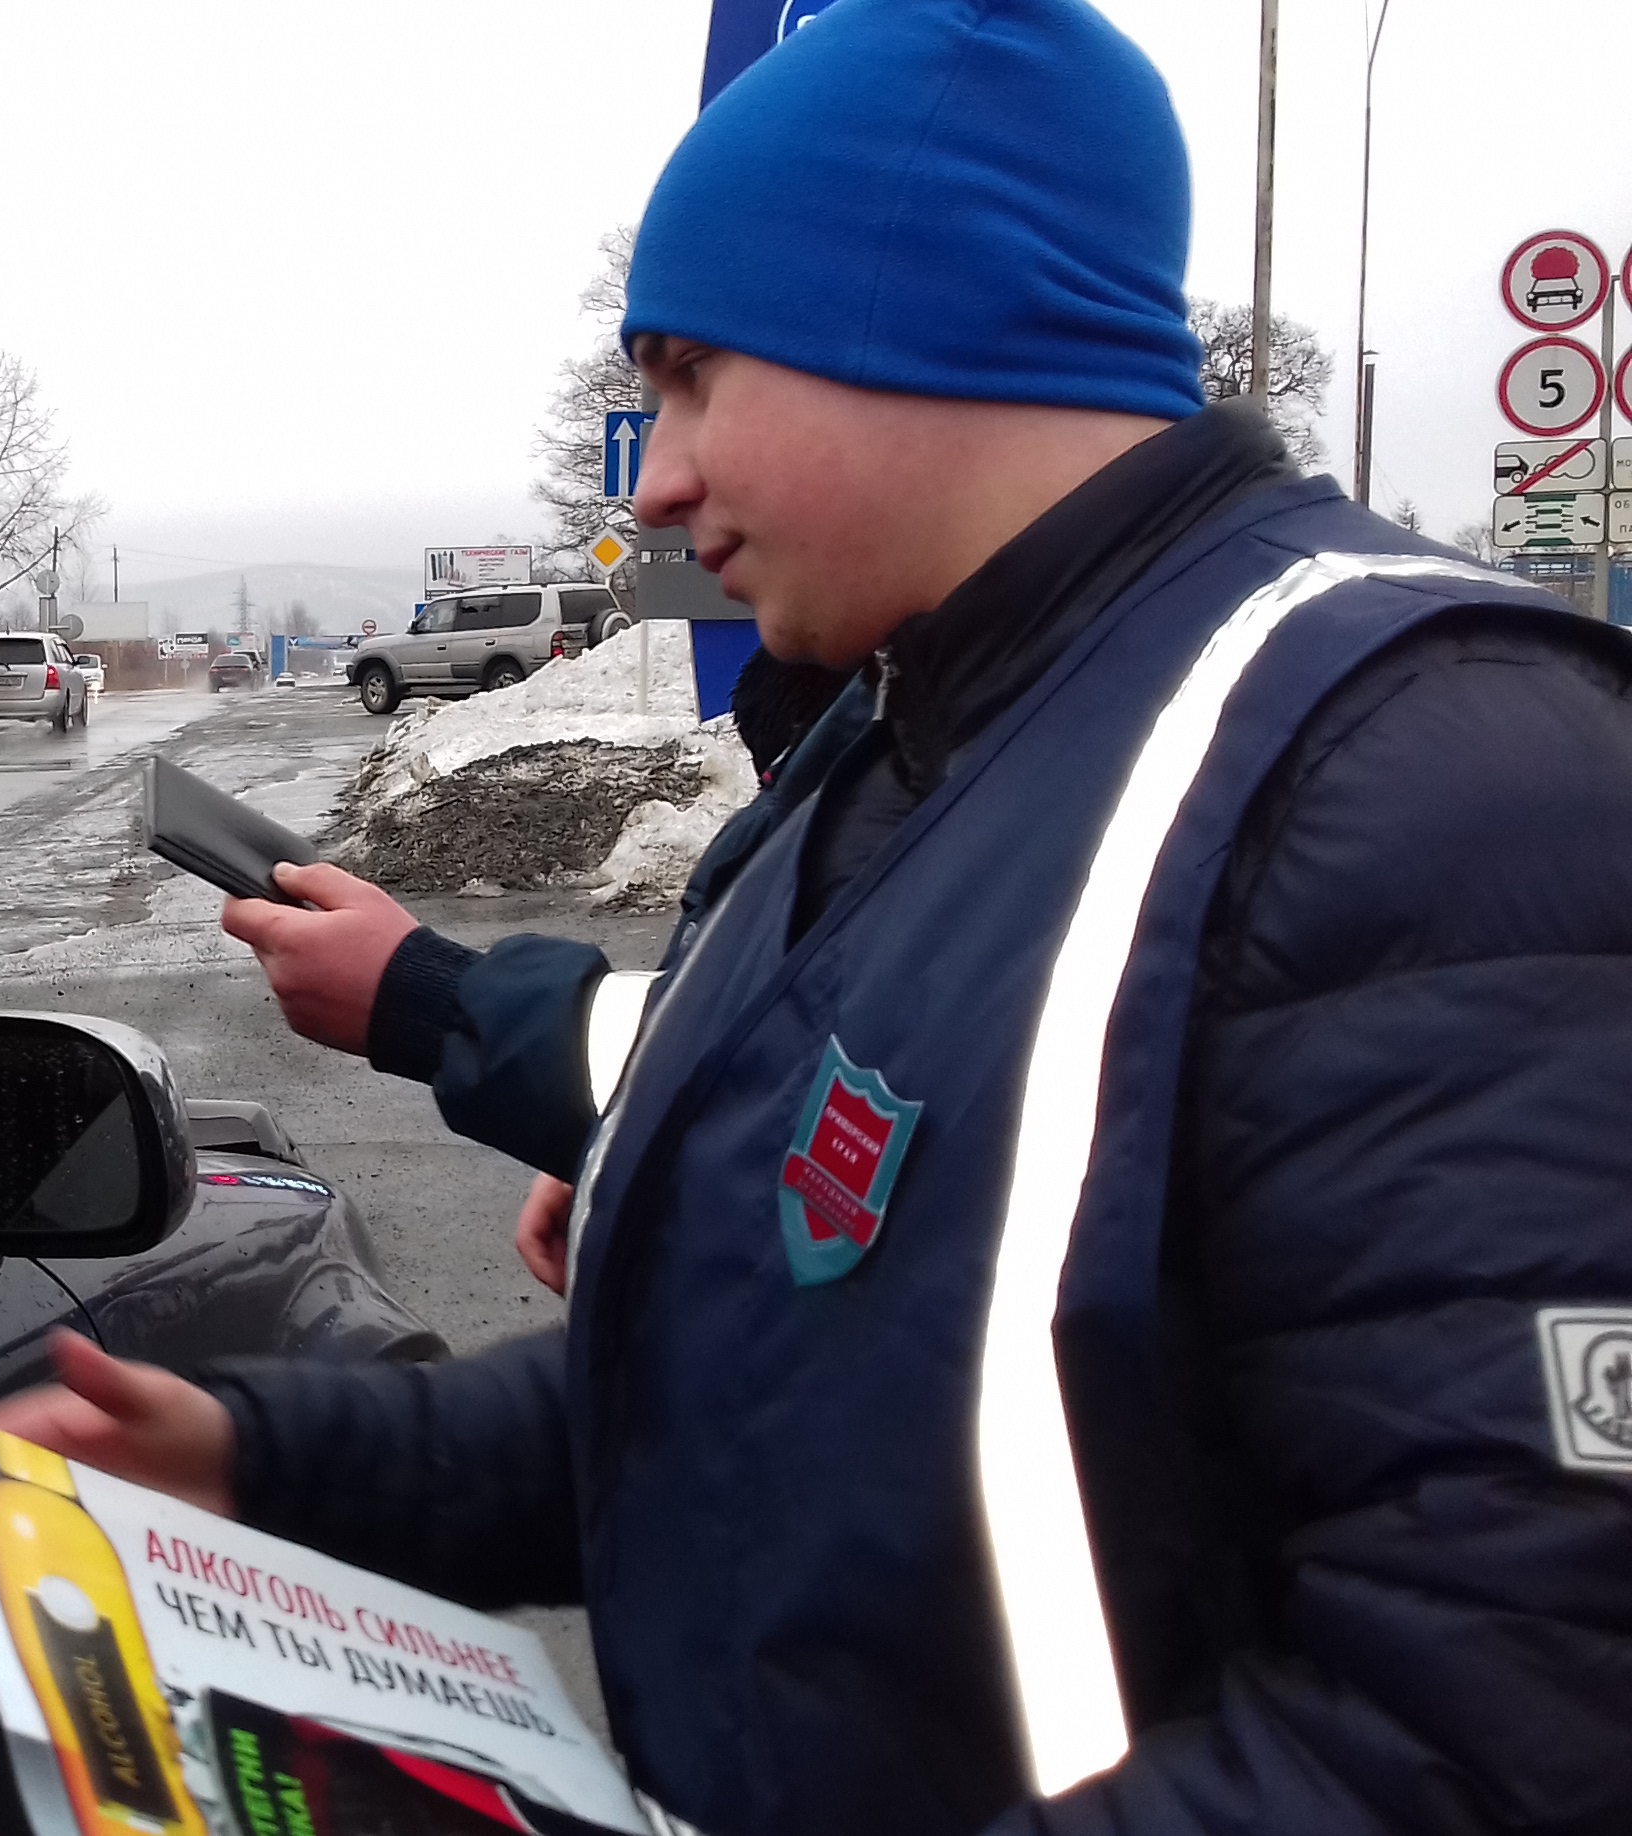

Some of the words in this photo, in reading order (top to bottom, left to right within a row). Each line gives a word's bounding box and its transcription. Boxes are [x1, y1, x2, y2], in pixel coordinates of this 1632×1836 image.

[1538, 369, 1565, 408] 5
[147, 1528, 347, 1632] АЛКОГОЛЬ
[155, 1581, 256, 1648] ЧЕМ
[261, 1618, 332, 1671] ТЫ
[72, 1654, 142, 1788] ALCOHOL
